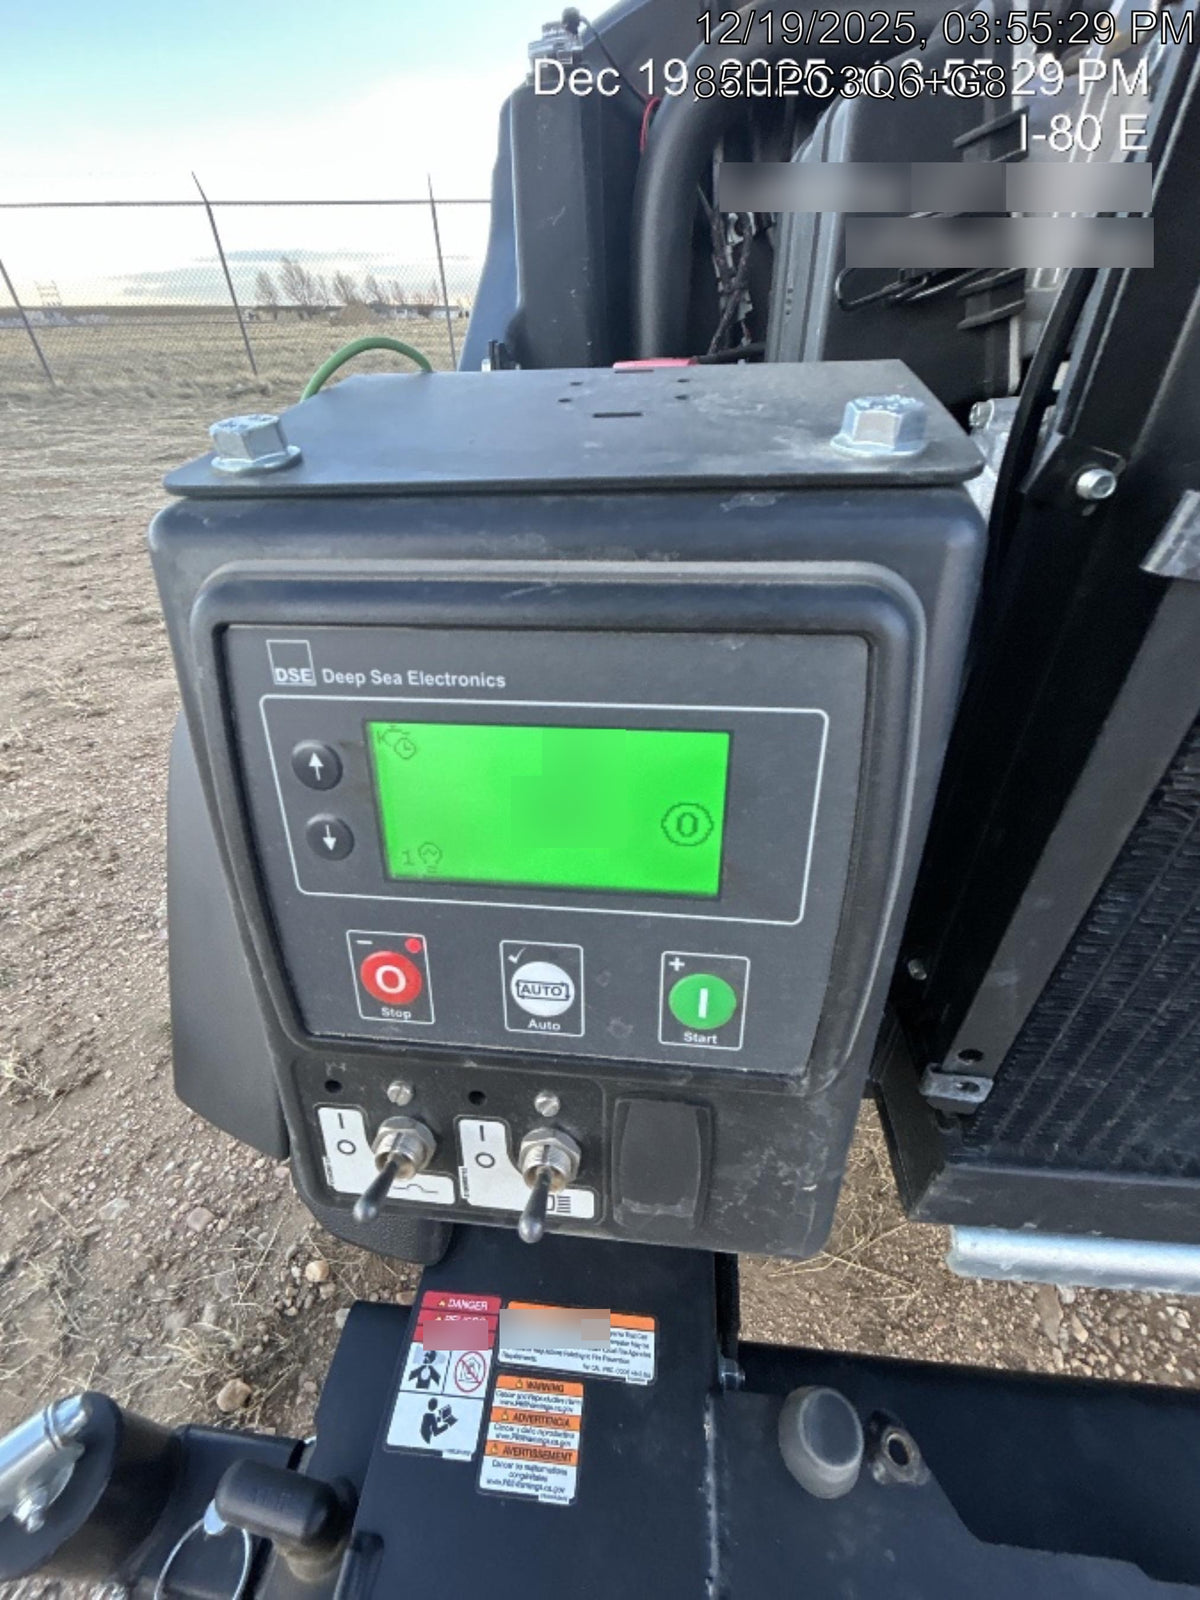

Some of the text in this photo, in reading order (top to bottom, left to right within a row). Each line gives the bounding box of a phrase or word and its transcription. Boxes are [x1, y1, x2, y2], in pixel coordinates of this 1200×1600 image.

[274, 667, 314, 683] DSE
[321, 668, 507, 689] Deep Sea Electronics
[520, 983, 565, 998] AUTO
[380, 1006, 412, 1022] Stop
[527, 1018, 562, 1032] Auto
[682, 1031, 718, 1046] Start
[447, 1297, 489, 1312] DANGER
